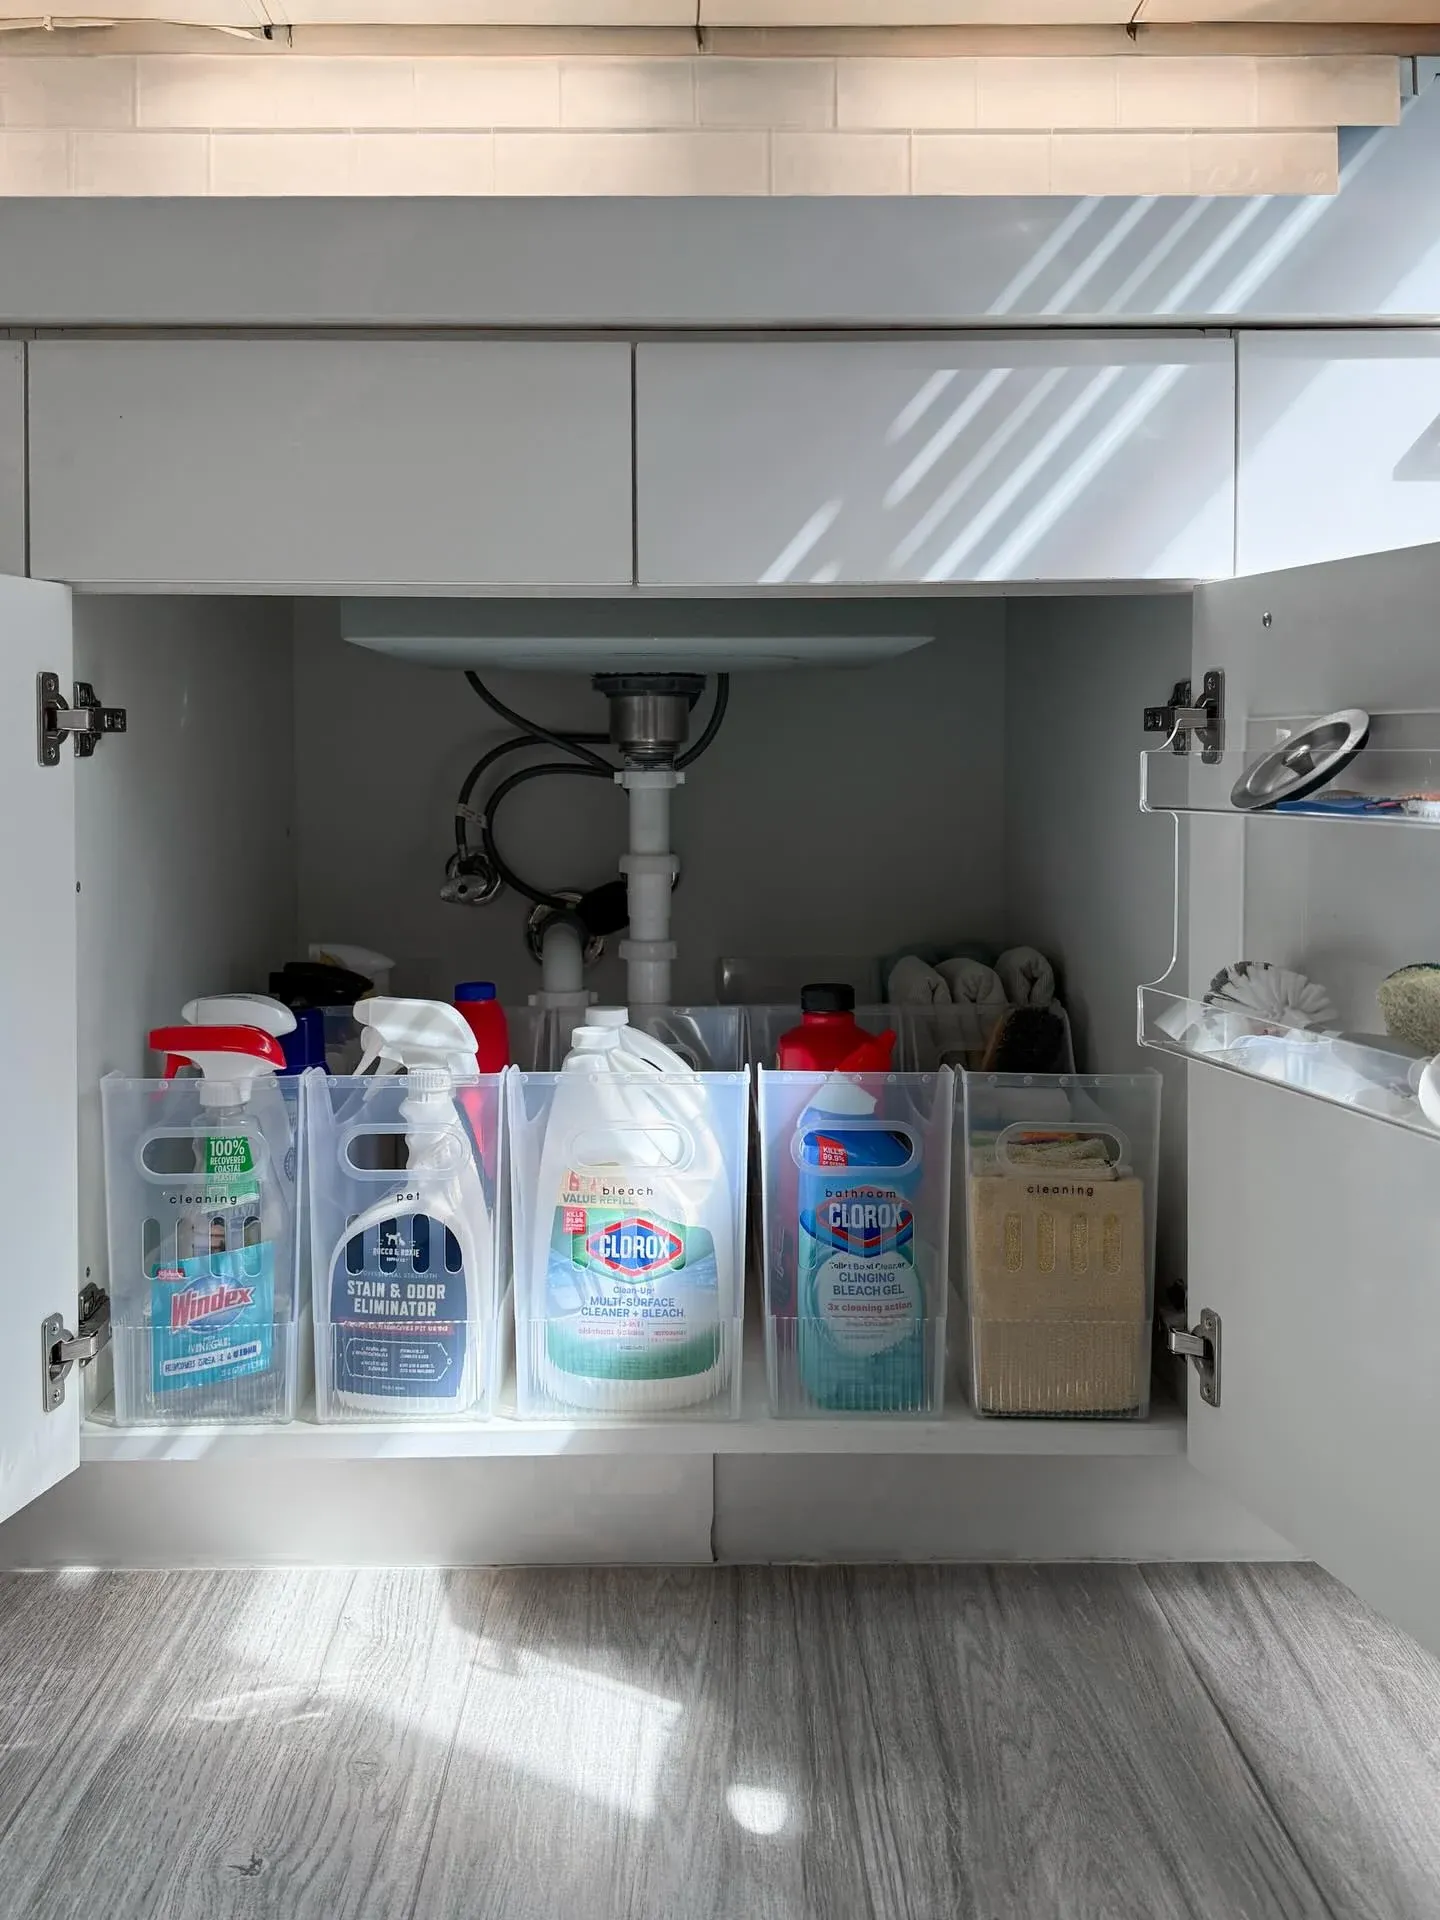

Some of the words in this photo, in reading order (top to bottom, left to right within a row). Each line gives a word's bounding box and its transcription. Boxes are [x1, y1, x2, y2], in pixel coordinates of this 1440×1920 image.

[210, 1139, 245, 1156] 100%
[210, 1156, 246, 1165] RECOVERED
[396, 1191, 420, 1203] pet
[602, 1186, 654, 1196] bleach
[825, 1189, 896, 1198] bathroom
[1027, 1184, 1094, 1197] cleaning
[169, 1193, 238, 1205] cleaning
[562, 1193, 597, 1204] VALUE
[828, 1202, 904, 1229] CLOROX
[600, 1234, 670, 1259] CLOROX
[839, 1271, 895, 1283] CLINGING
[347, 1280, 386, 1298] STAIN
[390, 1283, 401, 1298] &
[407, 1284, 446, 1300] ODOR
[833, 1284, 880, 1297] BLEACH
[882, 1284, 905, 1296] GEL
[354, 1298, 437, 1317] ELIMINATOR
[590, 1295, 675, 1308] MULTI-SURFACE
[827, 1303, 840, 1312] 3x
[841, 1303, 882, 1314] cleaning
[885, 1301, 913, 1312] action
[171, 1284, 256, 1335] Windex
[581, 1306, 630, 1317] CLEANER
[632, 1310, 640, 1318] +
[642, 1308, 684, 1318] BLEACH
